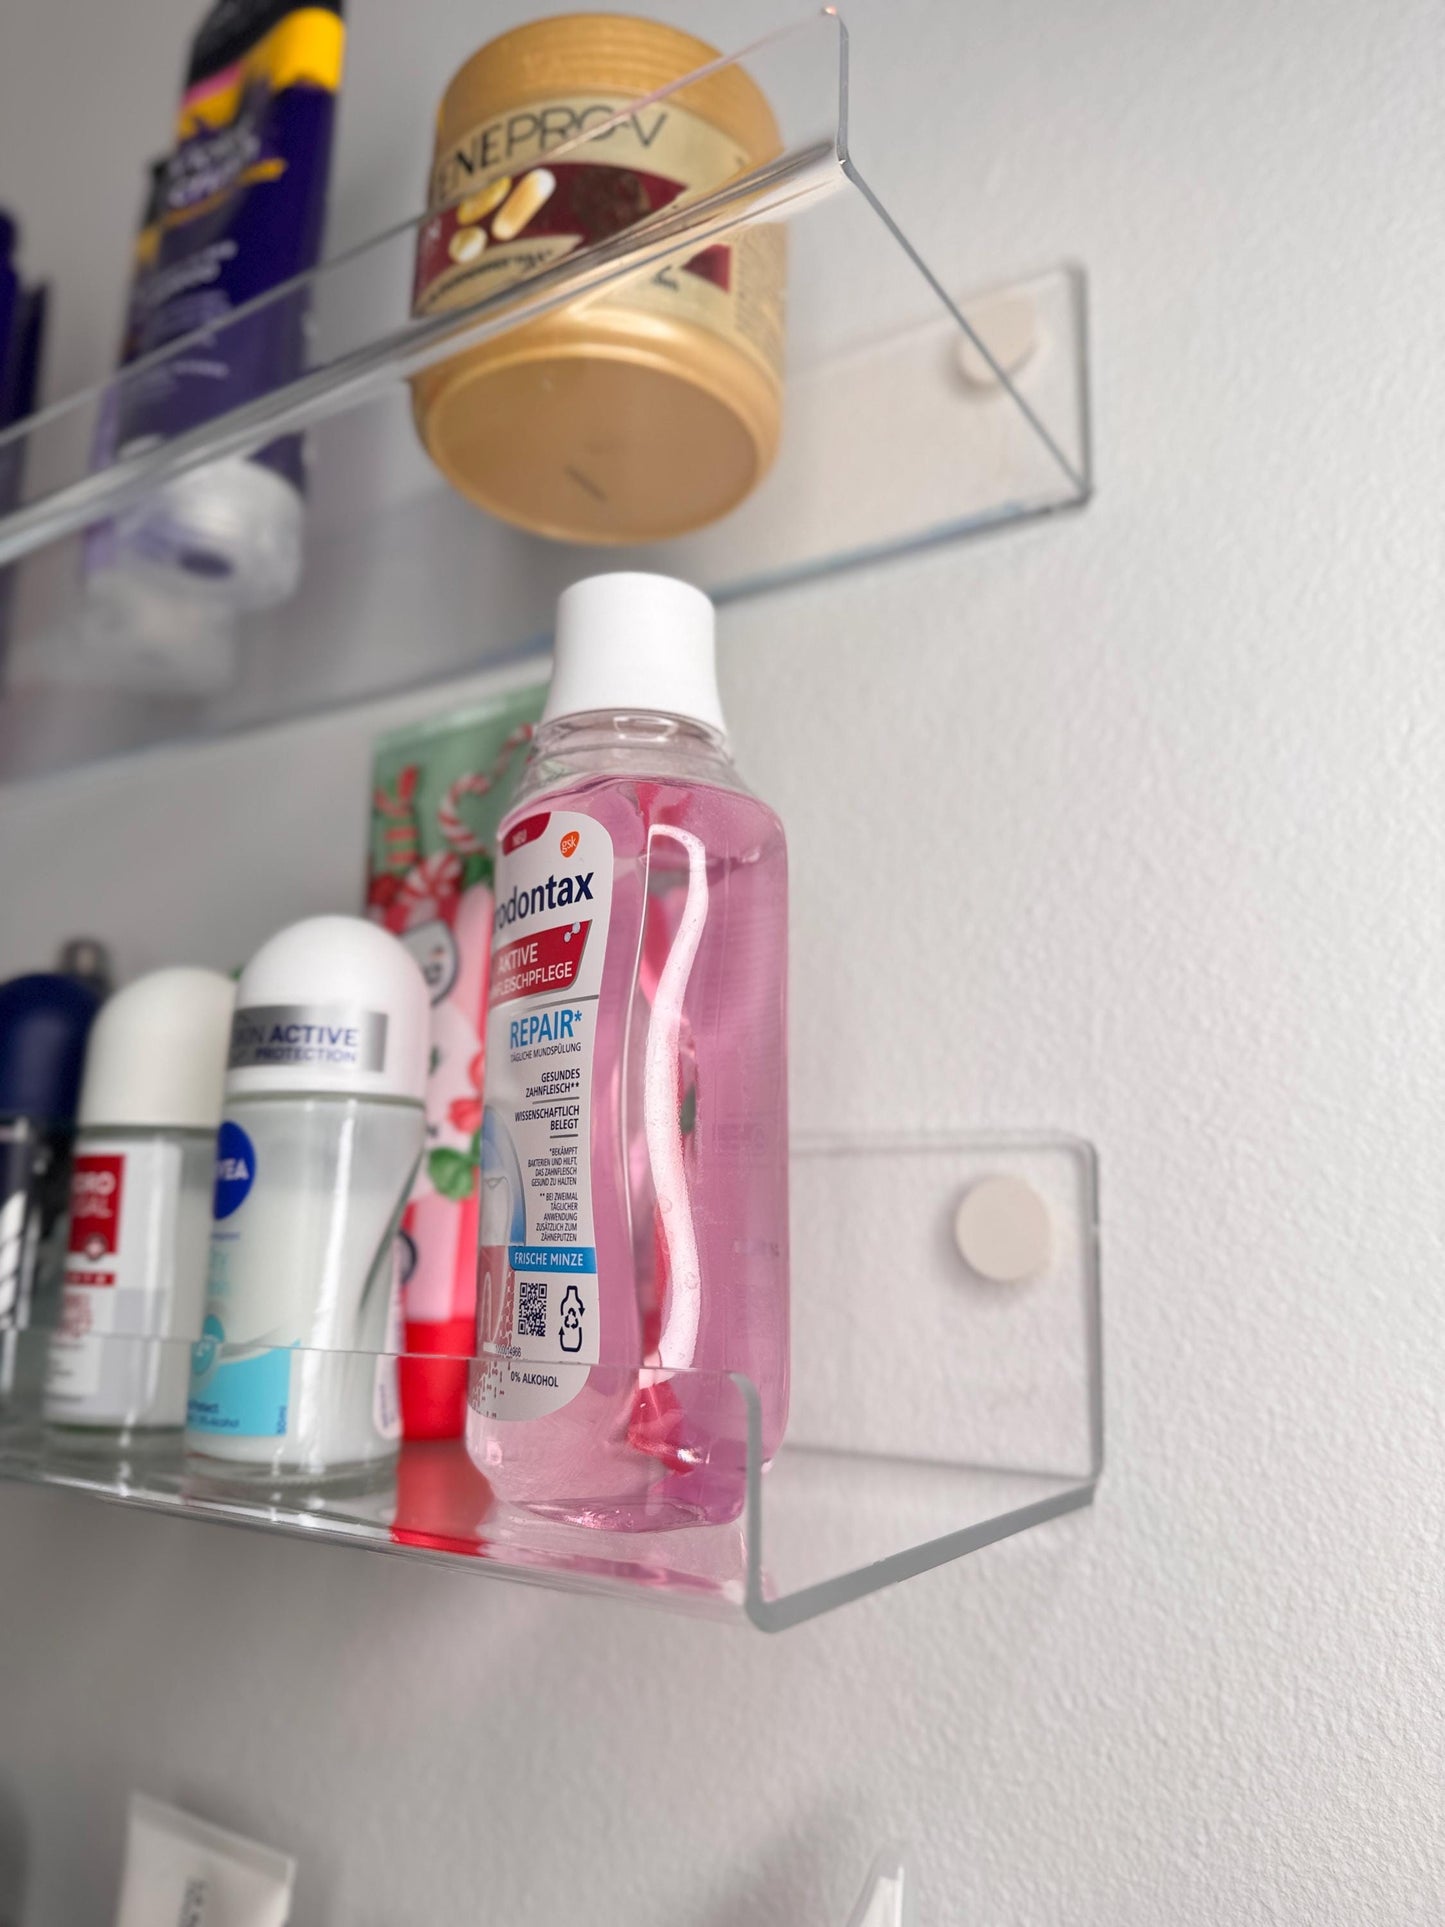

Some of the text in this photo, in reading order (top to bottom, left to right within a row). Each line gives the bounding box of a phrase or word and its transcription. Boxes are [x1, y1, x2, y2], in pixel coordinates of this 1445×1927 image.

[561, 835, 577, 854] gsk
[268, 1024, 359, 1047] ACTIVE
[255, 1046, 357, 1063] PROTECTION
[533, 1042, 582, 1059] MUNDSPÜLUNG
[541, 1068, 581, 1083] GESUNDES
[514, 1105, 580, 1122] WISSENSCHAFTLICH
[550, 1118, 579, 1131] BELEGT
[527, 1158, 550, 1168] BAKTERIEN
[551, 1157, 562, 1167] UND
[535, 1167, 577, 1177] DAS ZAHNFLEISCH
[531, 1176, 577, 1187] GESUND ZU HALTEN
[554, 1191, 579, 1201] ZWEIMAL
[550, 1201, 578, 1211] TÄGLICHER
[543, 1212, 578, 1222] ANWENDUNG
[536, 1222, 578, 1232] ZUSÄTZLICH ZUM
[541, 1232, 578, 1242] ZÄHNEPUTZEN
[514, 1251, 584, 1267] FRISCHE MINZE
[510, 1370, 560, 1388] 0% ALKOHOL
